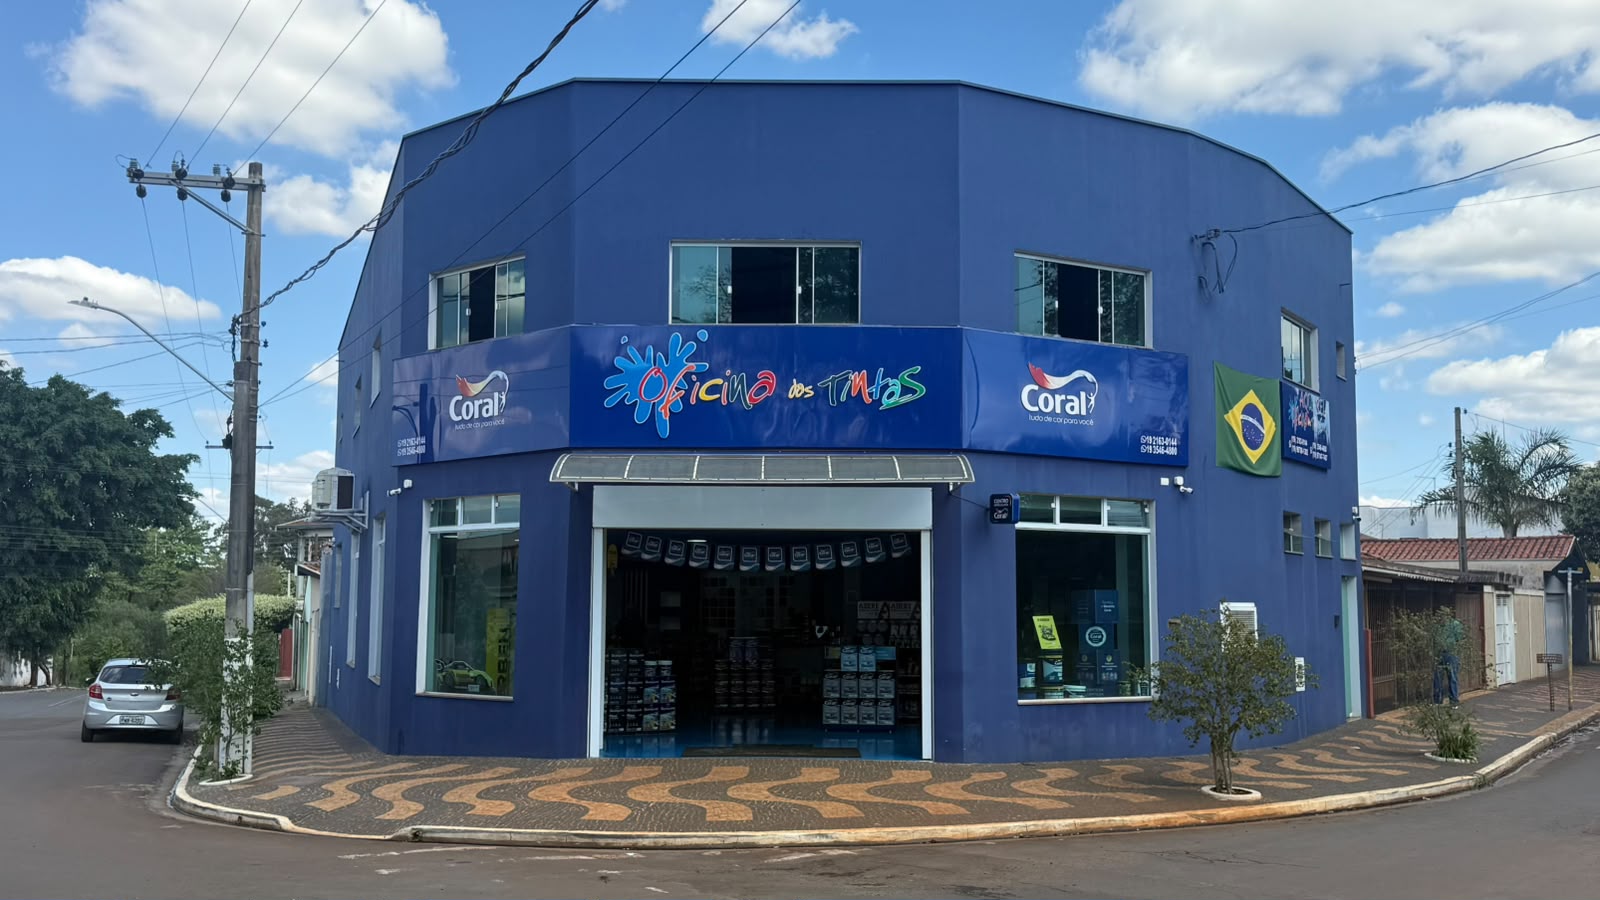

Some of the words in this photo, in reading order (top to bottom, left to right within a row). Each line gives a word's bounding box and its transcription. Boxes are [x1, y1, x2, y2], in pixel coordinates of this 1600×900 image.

[449, 391, 499, 421] Coral
[638, 365, 776, 420] Oficina
[1021, 384, 1087, 416] Coral
[1043, 415, 1052, 423] de
